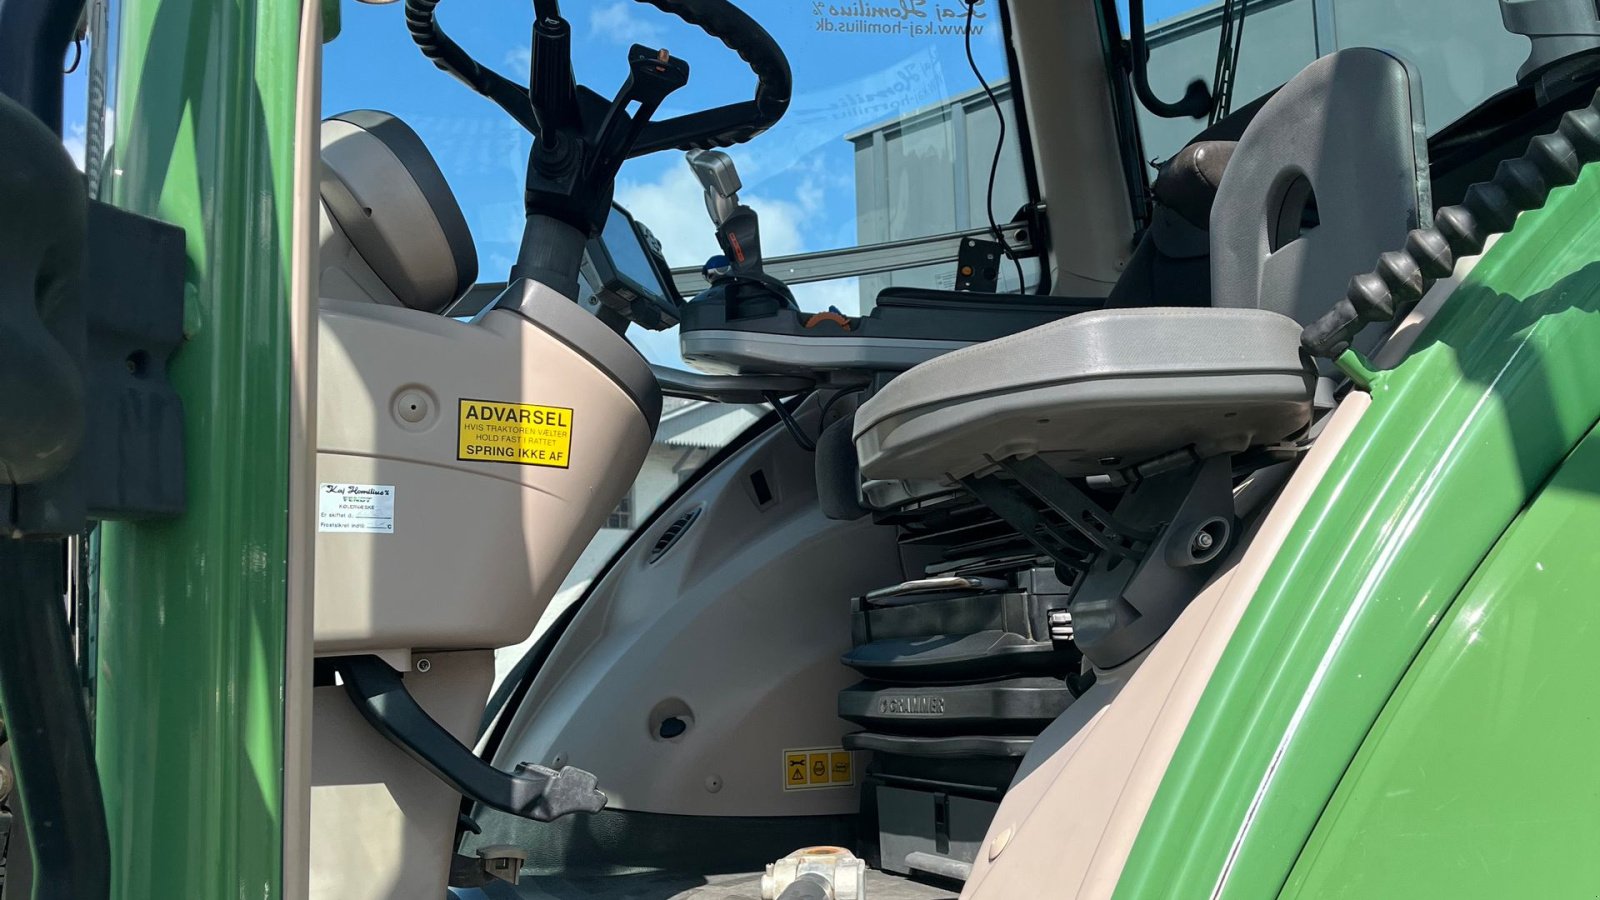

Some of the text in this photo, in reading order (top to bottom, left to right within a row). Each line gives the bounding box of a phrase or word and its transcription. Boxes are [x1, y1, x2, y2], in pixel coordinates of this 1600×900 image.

[465, 405, 567, 428] ADVARSEL
[464, 423, 568, 438] HVIS TRAKTOREN VÆLTER
[476, 433, 499, 442] HOLD
[501, 435, 521, 443] FAST
[528, 437, 557, 447] RATTET
[466, 444, 564, 461] SPRING IKKE AF
[325, 485, 345, 495] Kaj
[347, 485, 384, 496] Homilius
[889, 697, 944, 714] GRAMMER
